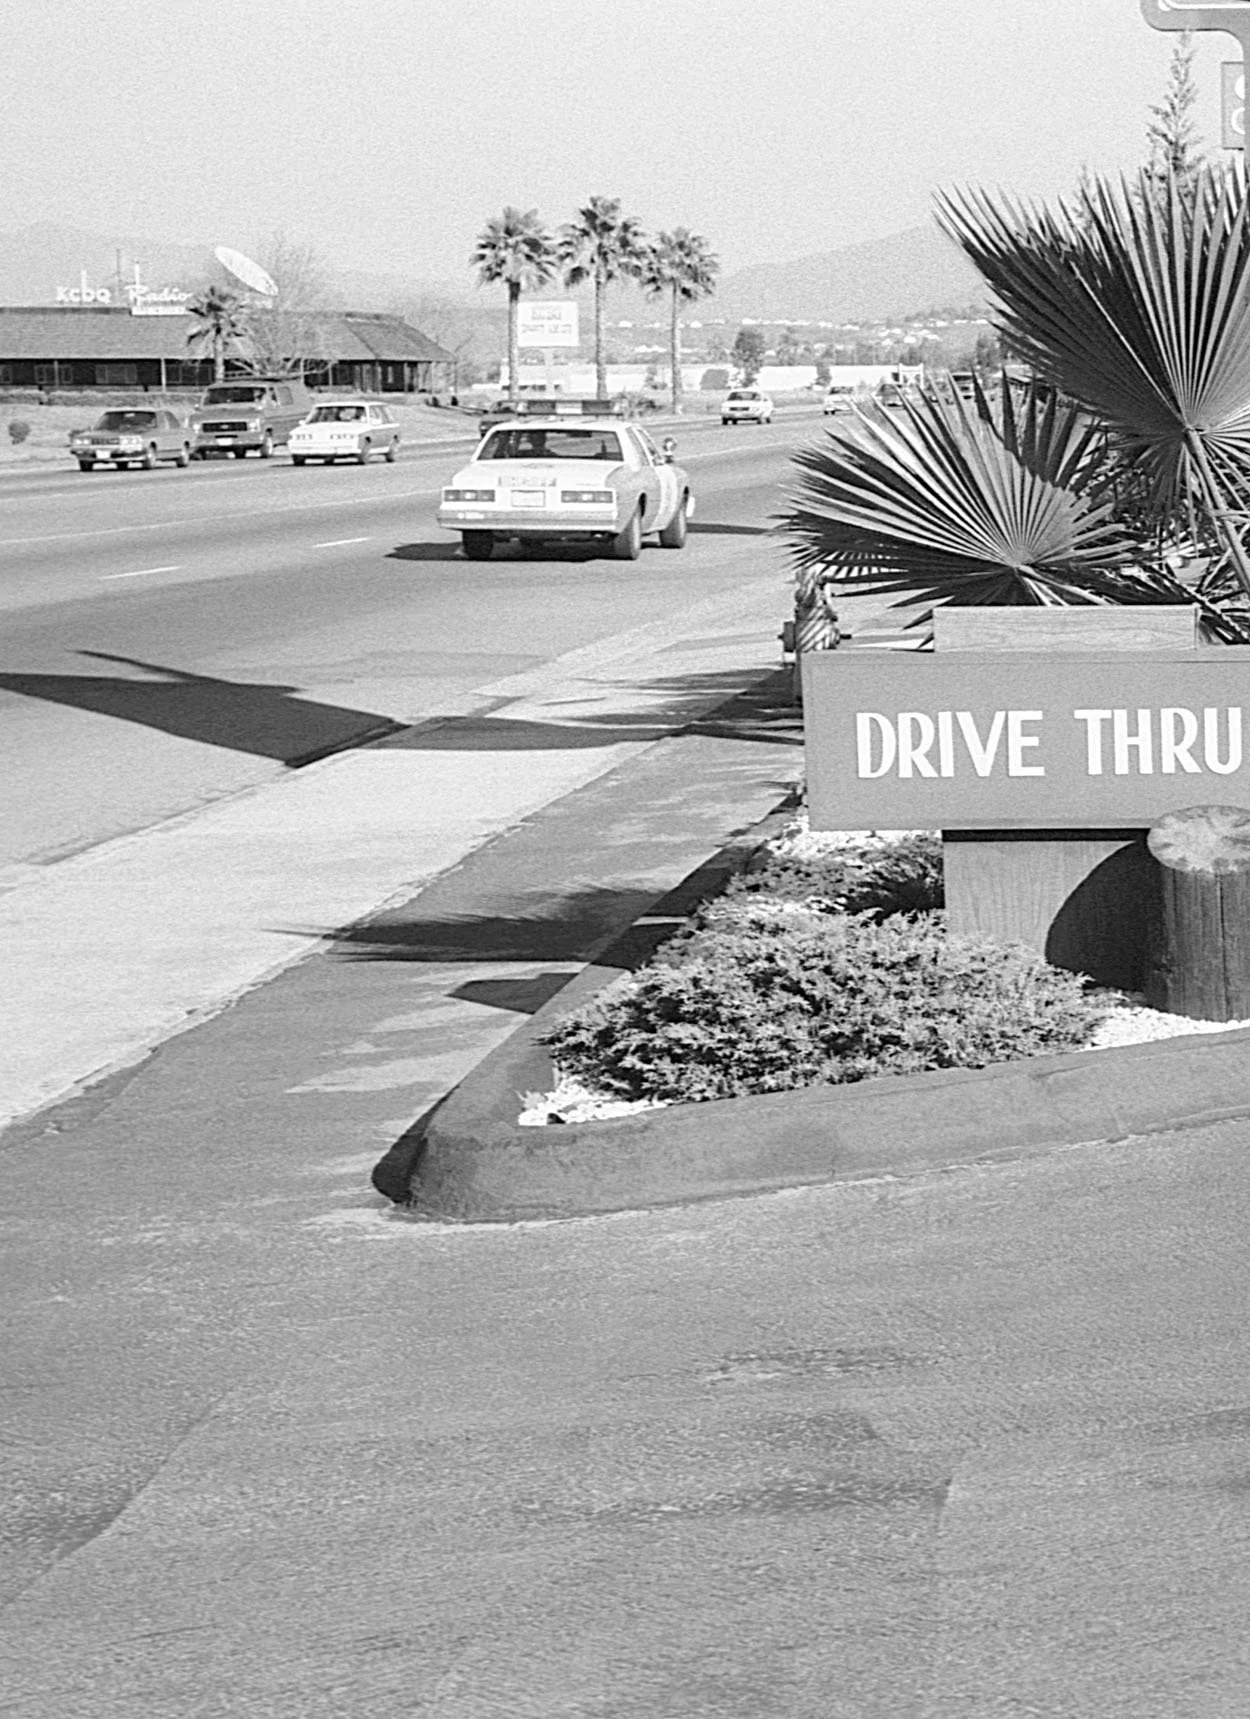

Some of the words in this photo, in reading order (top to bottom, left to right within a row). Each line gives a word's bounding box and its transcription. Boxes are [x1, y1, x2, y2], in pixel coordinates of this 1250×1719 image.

[124, 285, 193, 305] Radio
[856, 710, 1045, 778] DRIVE
[1074, 706, 1242, 775] THRU
